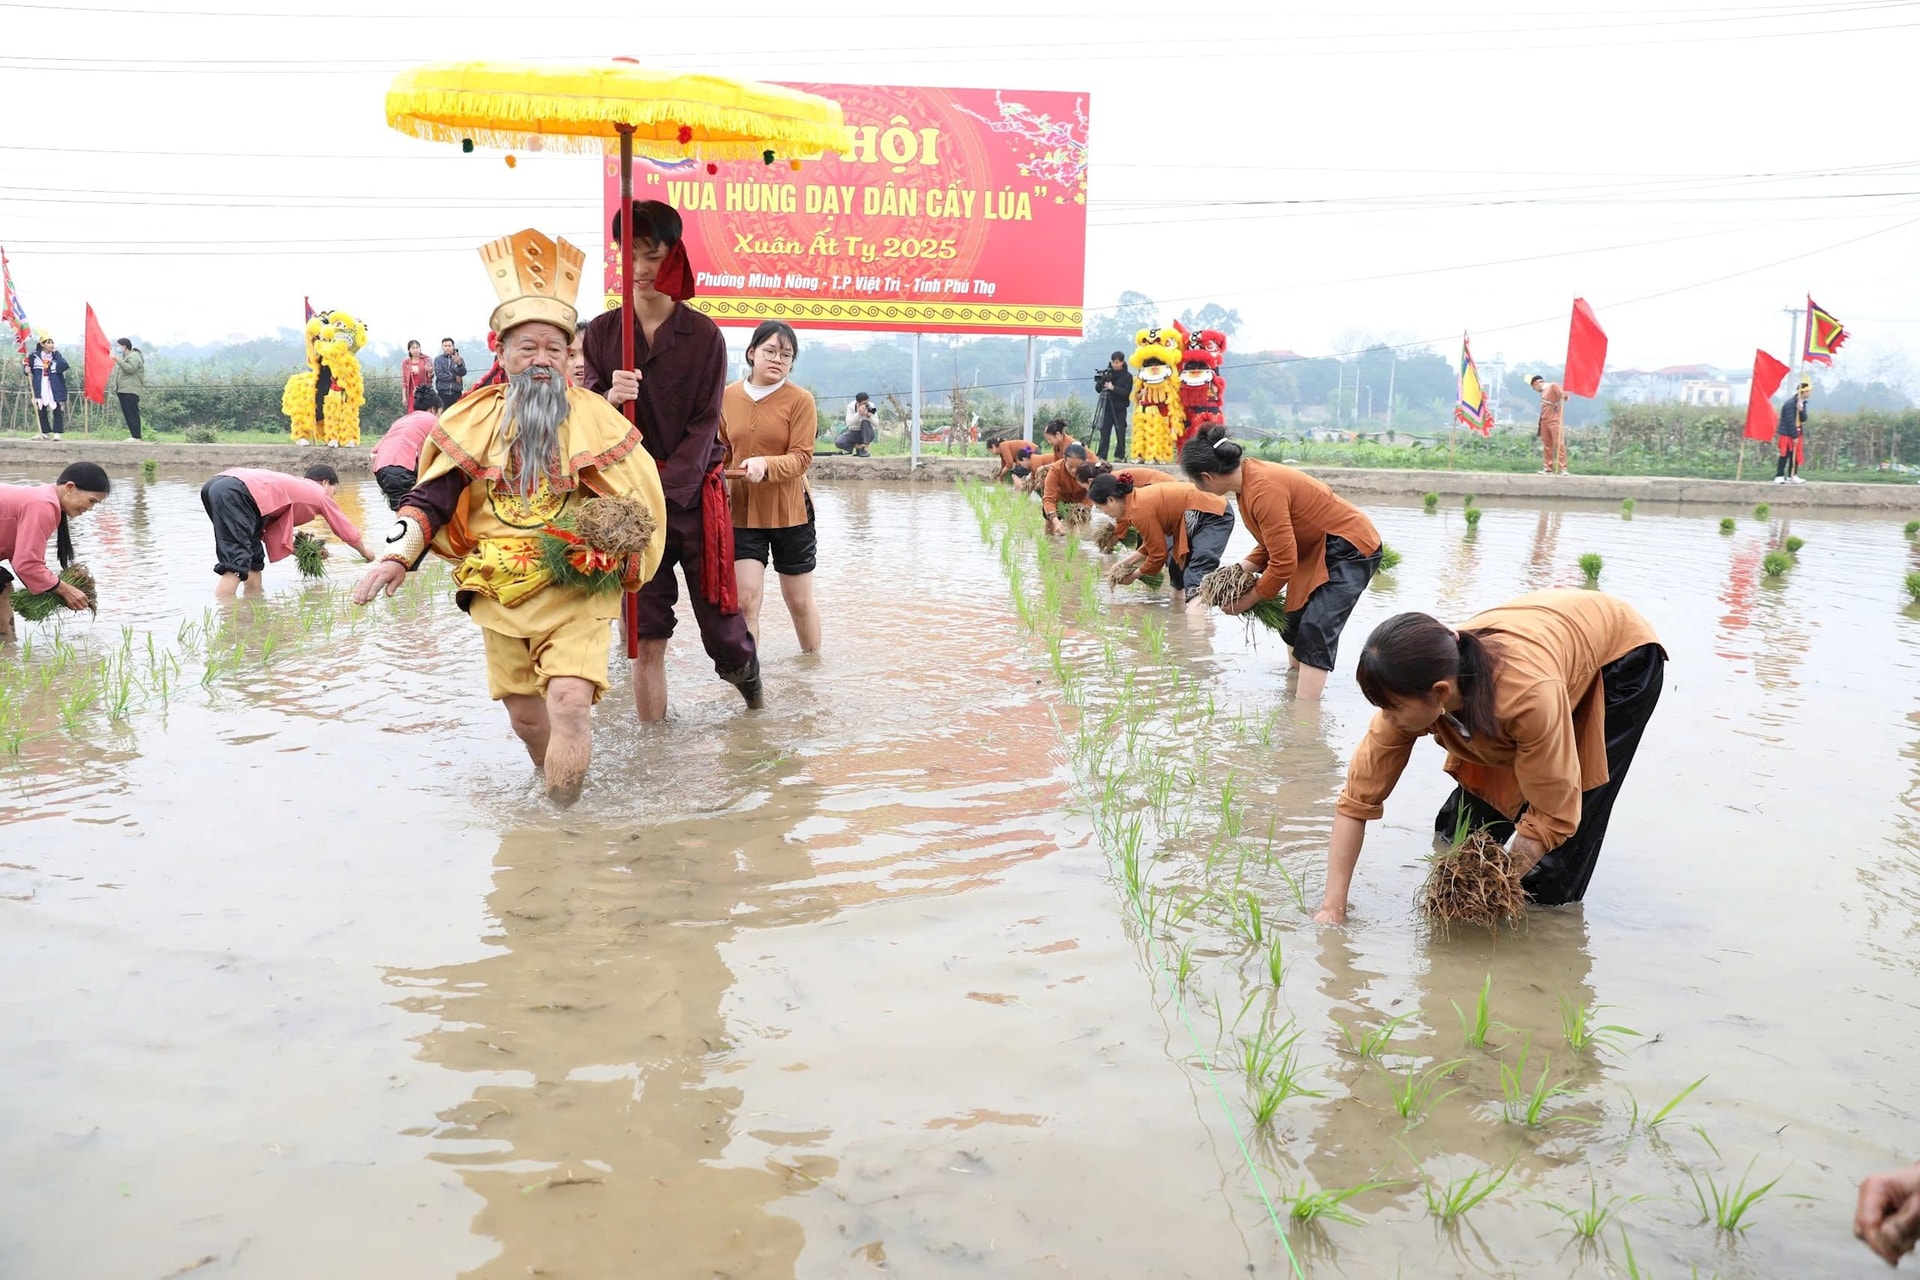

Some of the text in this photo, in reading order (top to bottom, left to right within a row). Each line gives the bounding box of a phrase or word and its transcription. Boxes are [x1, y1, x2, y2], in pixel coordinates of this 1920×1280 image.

[839, 114, 940, 174] HỘI
[667, 180, 717, 212] VUA
[725, 176, 797, 214] HÙNG
[805, 184, 856, 221] DẠY
[863, 181, 918, 217] DÂN
[925, 179, 976, 219] CẤY
[733, 233, 804, 255] Xuân
[808, 227, 841, 256] Ất
[883, 237, 958, 260] 2025
[696, 271, 746, 289] Phường
[748, 273, 782, 289] Minh
[784, 274, 819, 292] Nông
[831, 275, 852, 290] T.P
[855, 276, 881, 294] Việt
[943, 279, 970, 293] Phú
[973, 279, 996, 298] Thọ
